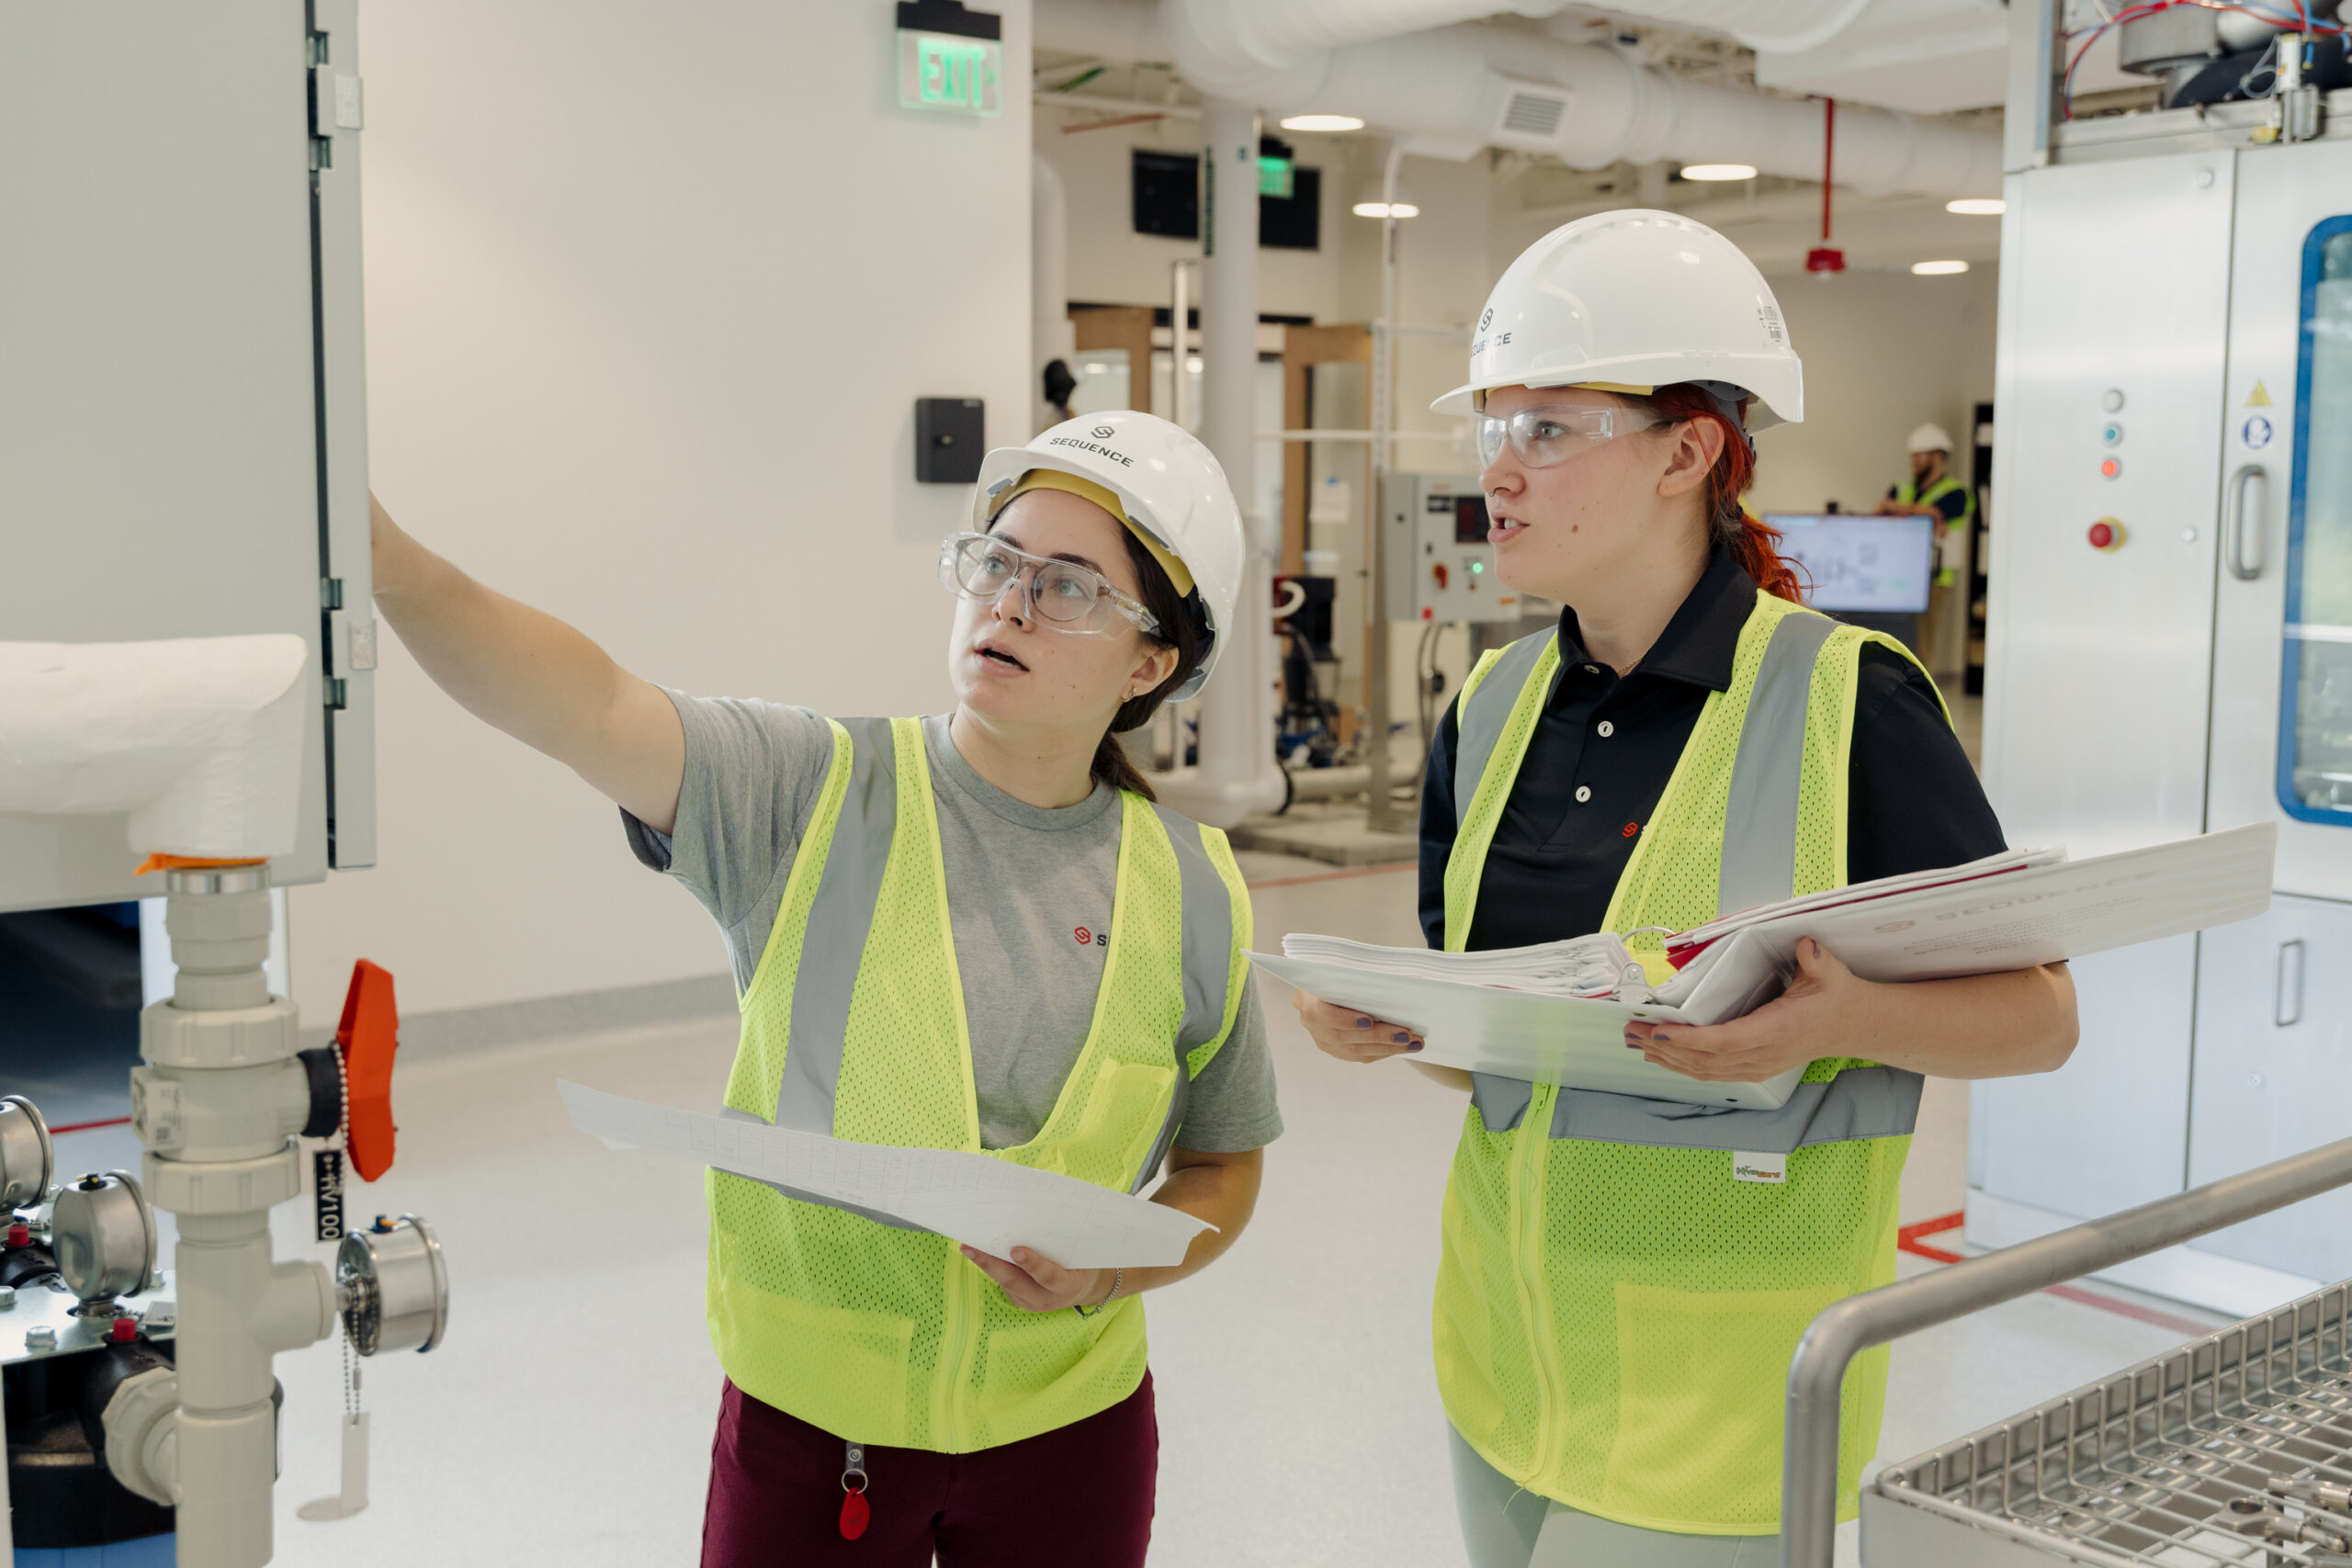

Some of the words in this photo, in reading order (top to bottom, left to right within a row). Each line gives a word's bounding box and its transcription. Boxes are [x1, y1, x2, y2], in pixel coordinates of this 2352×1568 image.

[917, 37, 986, 107] EXIT
[1049, 437, 1134, 468] SEQUENCE
[1096, 934, 1110, 946] S
